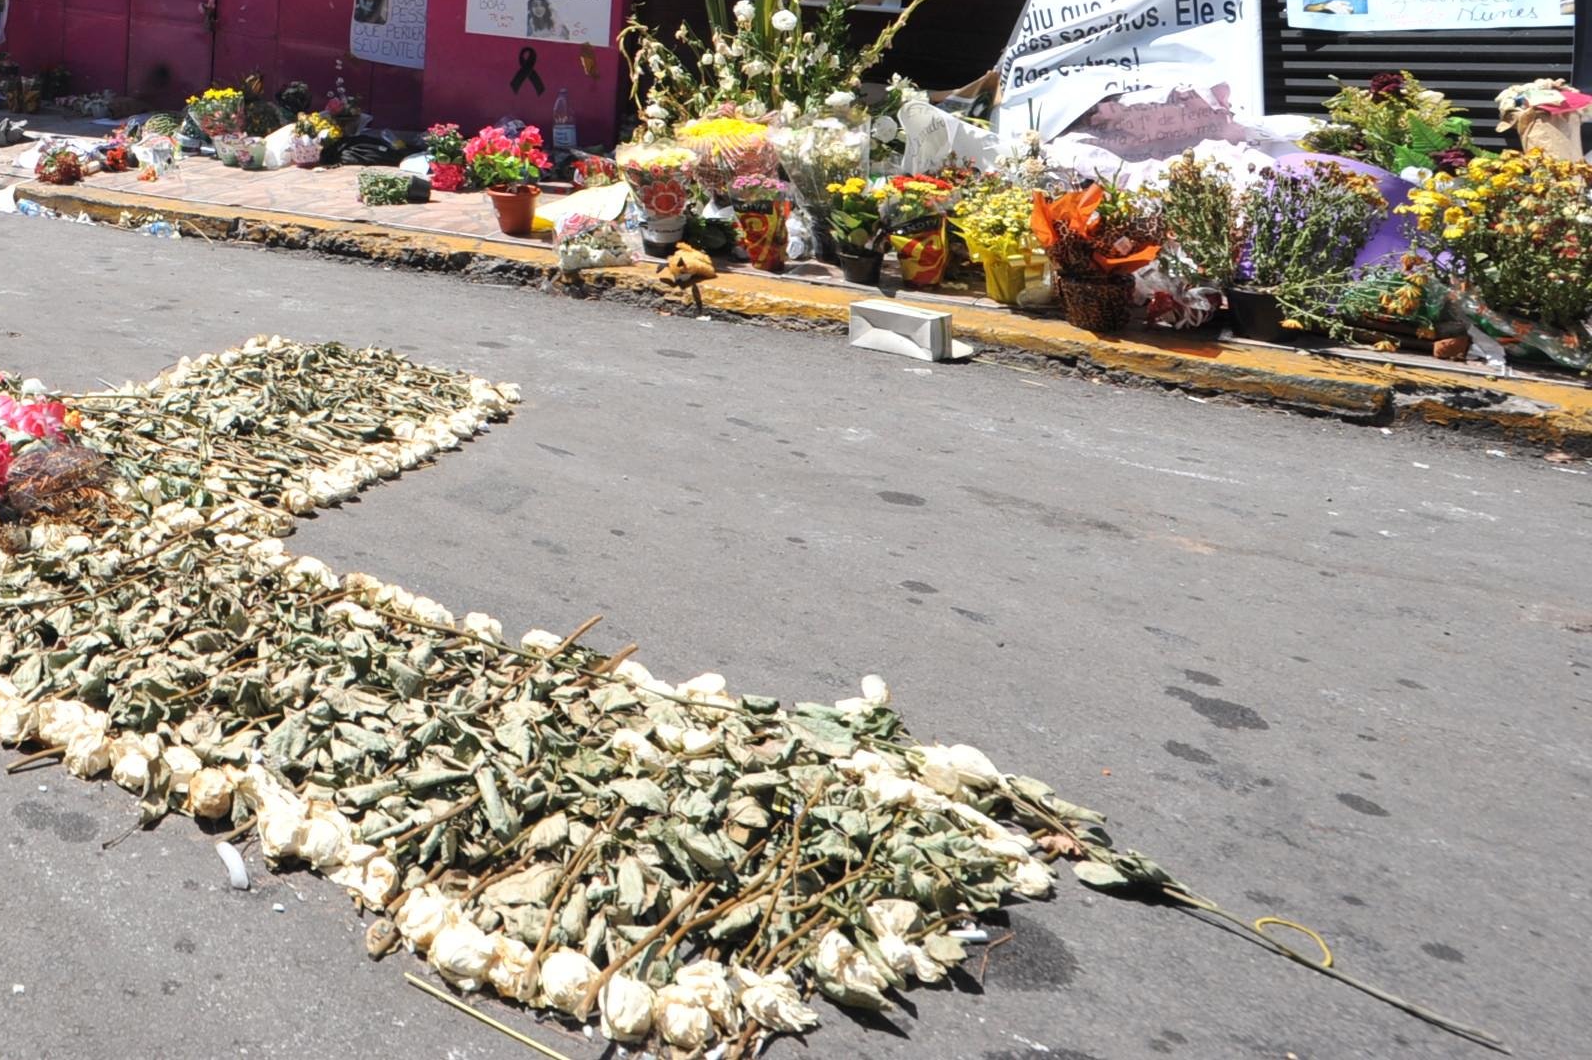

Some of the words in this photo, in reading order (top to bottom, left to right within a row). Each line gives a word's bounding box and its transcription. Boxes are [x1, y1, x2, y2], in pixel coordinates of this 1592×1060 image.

[1456, 3, 1539, 22] Nunes
[353, 24, 381, 38] QUE
[353, 38, 379, 54] SEU
[382, 40, 414, 60] ENTE
